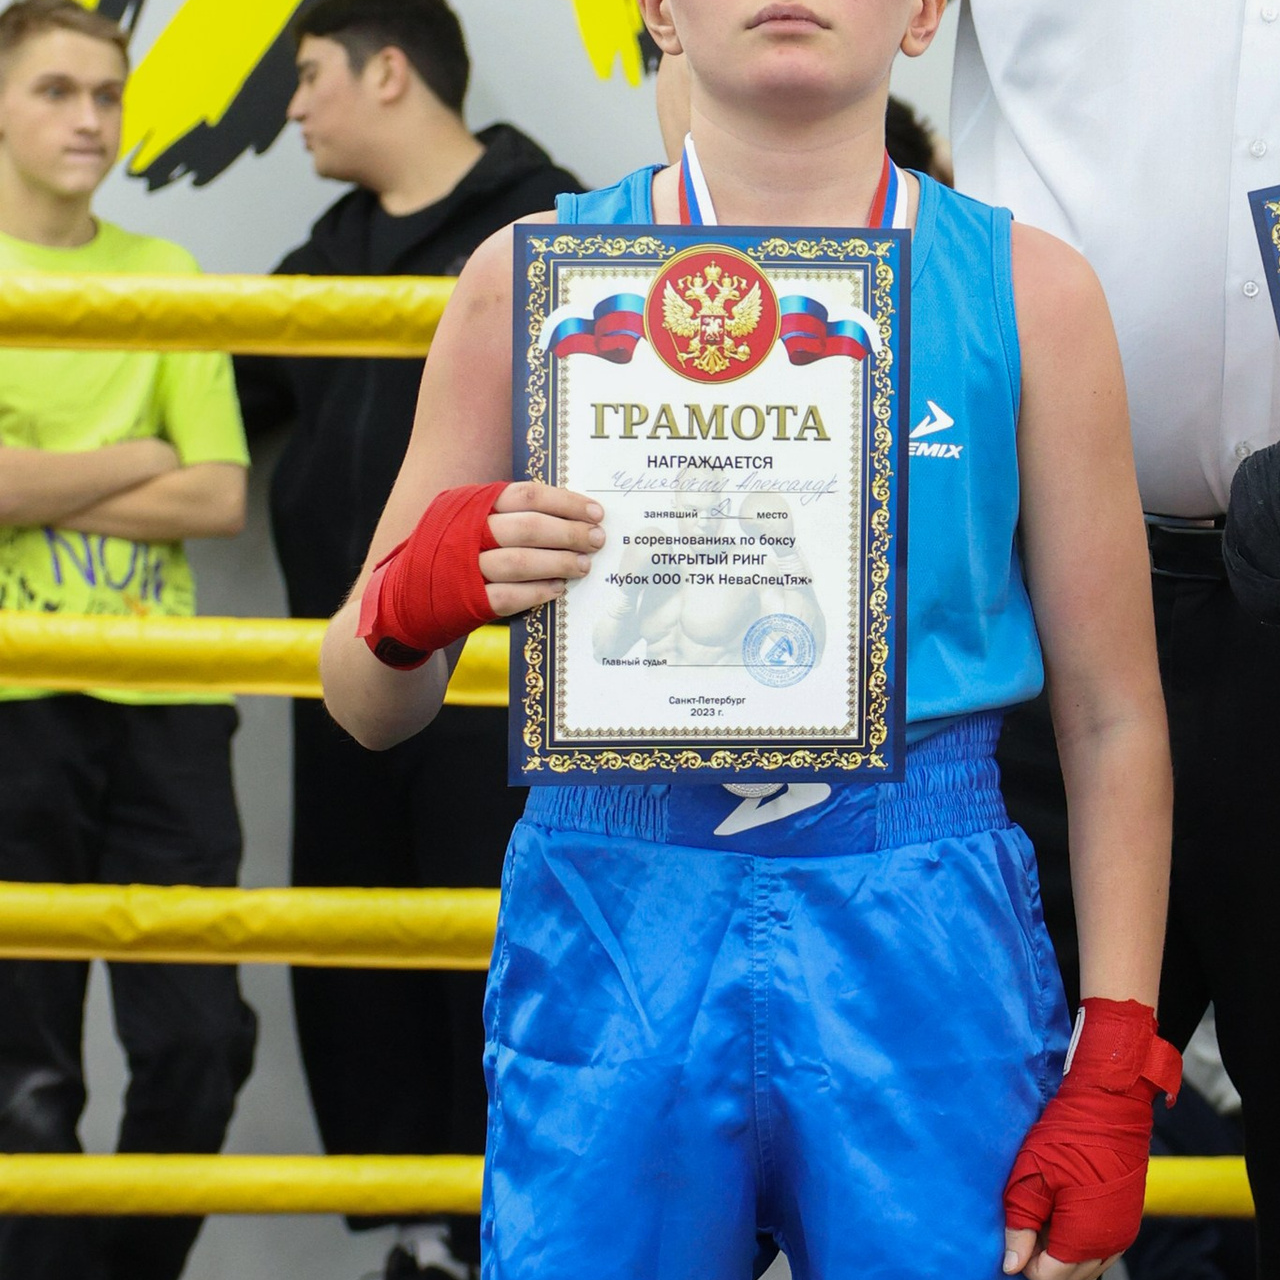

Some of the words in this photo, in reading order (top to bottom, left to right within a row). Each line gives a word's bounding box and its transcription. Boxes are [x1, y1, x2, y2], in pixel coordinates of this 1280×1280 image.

[590, 403, 831, 441] ГРАМОТА
[908, 442, 964, 459] EMIX
[647, 455, 773, 471] НАГРАЖДАЕТСЯ
[644, 509, 698, 519] занявший
[711, 498, 731, 517] 2
[757, 512, 788, 520] место
[623, 536, 631, 544] в
[635, 536, 736, 547] соревнованиях
[740, 537, 755, 545] по
[760, 535, 796, 547] боксу
[652, 551, 728, 565] ОТКРЫТЫЙ
[733, 554, 767, 565] РИНГ
[605, 573, 649, 586] «Кубок
[652, 574, 681, 585] ООО
[685, 574, 714, 585] «ТЭК
[602, 658, 640, 666] Главный
[643, 659, 667, 668] судья
[668, 696, 746, 707] Санкт-Петербург
[691, 708, 715, 716] 2023
